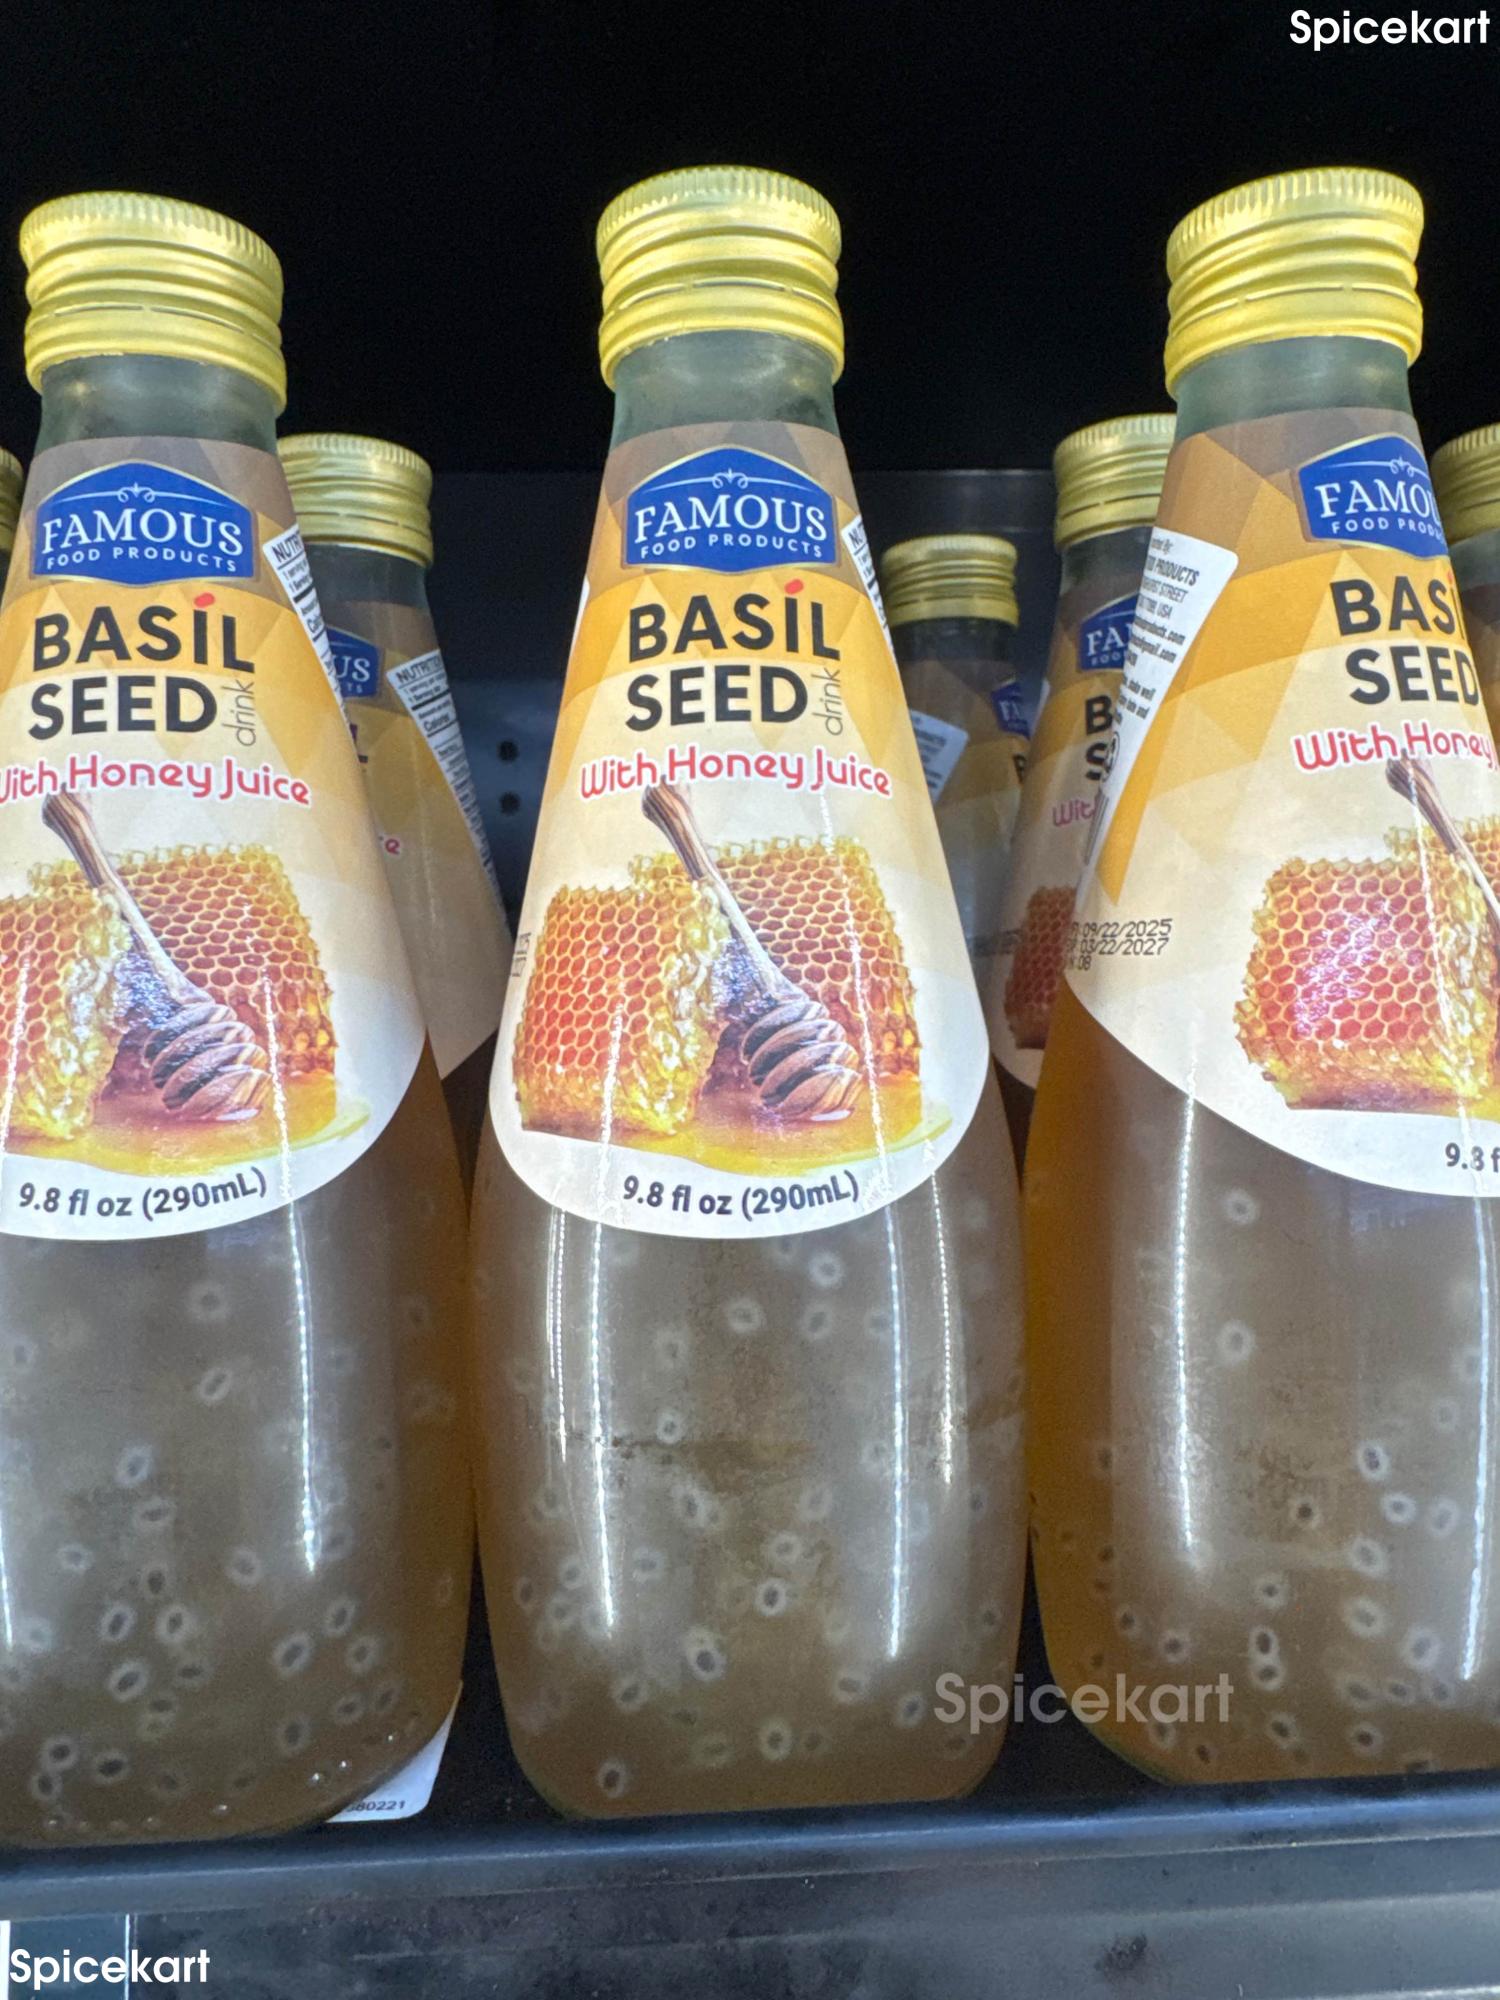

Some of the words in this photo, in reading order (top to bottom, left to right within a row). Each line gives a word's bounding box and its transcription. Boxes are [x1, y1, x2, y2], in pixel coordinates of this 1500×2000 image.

[634, 494, 828, 543] FAMOUS
[1314, 478, 1441, 527] FAMOU
[1331, 516, 1389, 535] FOOD
[42, 507, 244, 557] FAMOUS
[640, 535, 698, 559] FOOD
[708, 534, 823, 558] PRODUCTS
[46, 547, 101, 571] FOOD
[112, 547, 238, 573] PRODUCTS
[1155, 558, 1200, 587] PRODUCTS
[625, 664, 809, 732] SEED
[811, 668, 845, 736] drink
[1345, 645, 1480, 706] SEED
[28, 675, 218, 741] SEED
[220, 679, 257, 747] drink
[1293, 724, 1398, 771] With
[1403, 722, 1494, 769] Honey
[69, 756, 212, 799] Honey
[219, 758, 311, 805] Juice
[581, 752, 659, 799] With
[668, 746, 805, 791] Honey
[811, 748, 891, 796] Juice
[1444, 1141, 1485, 1172] 9.8
[19, 1182, 61, 1213] 9.8
[68, 1188, 90, 1216] fl
[96, 1197, 133, 1217] oz
[142, 1166, 267, 1221] (290mL)
[623, 1174, 665, 1208] 9.8
[671, 1184, 691, 1213] fl
[699, 1194, 733, 1215] oz
[741, 1169, 859, 1221] (290mL)
